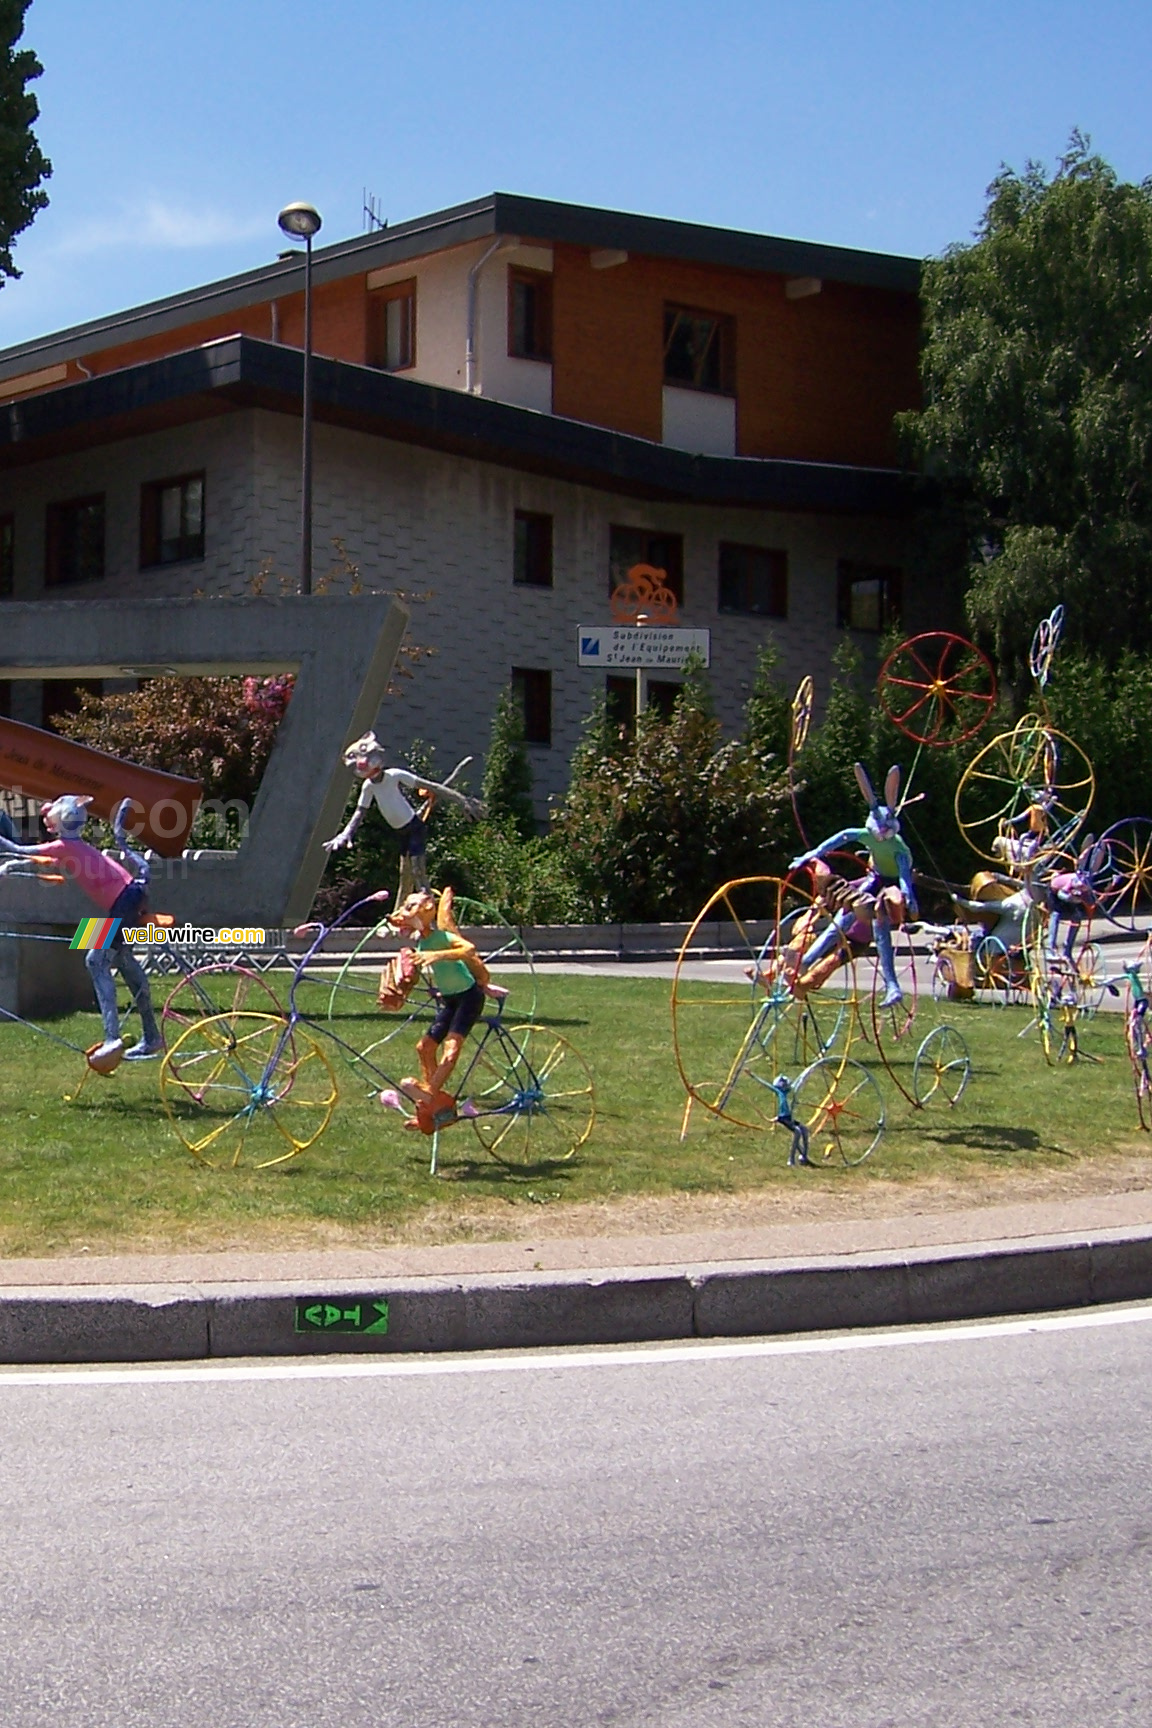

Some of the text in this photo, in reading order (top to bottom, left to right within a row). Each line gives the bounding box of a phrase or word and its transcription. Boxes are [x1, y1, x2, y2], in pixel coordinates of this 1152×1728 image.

[613, 630, 674, 641] Subdivision
[613, 642, 625, 651] de
[606, 653, 617, 663] St
[619, 654, 643, 663] Jean
